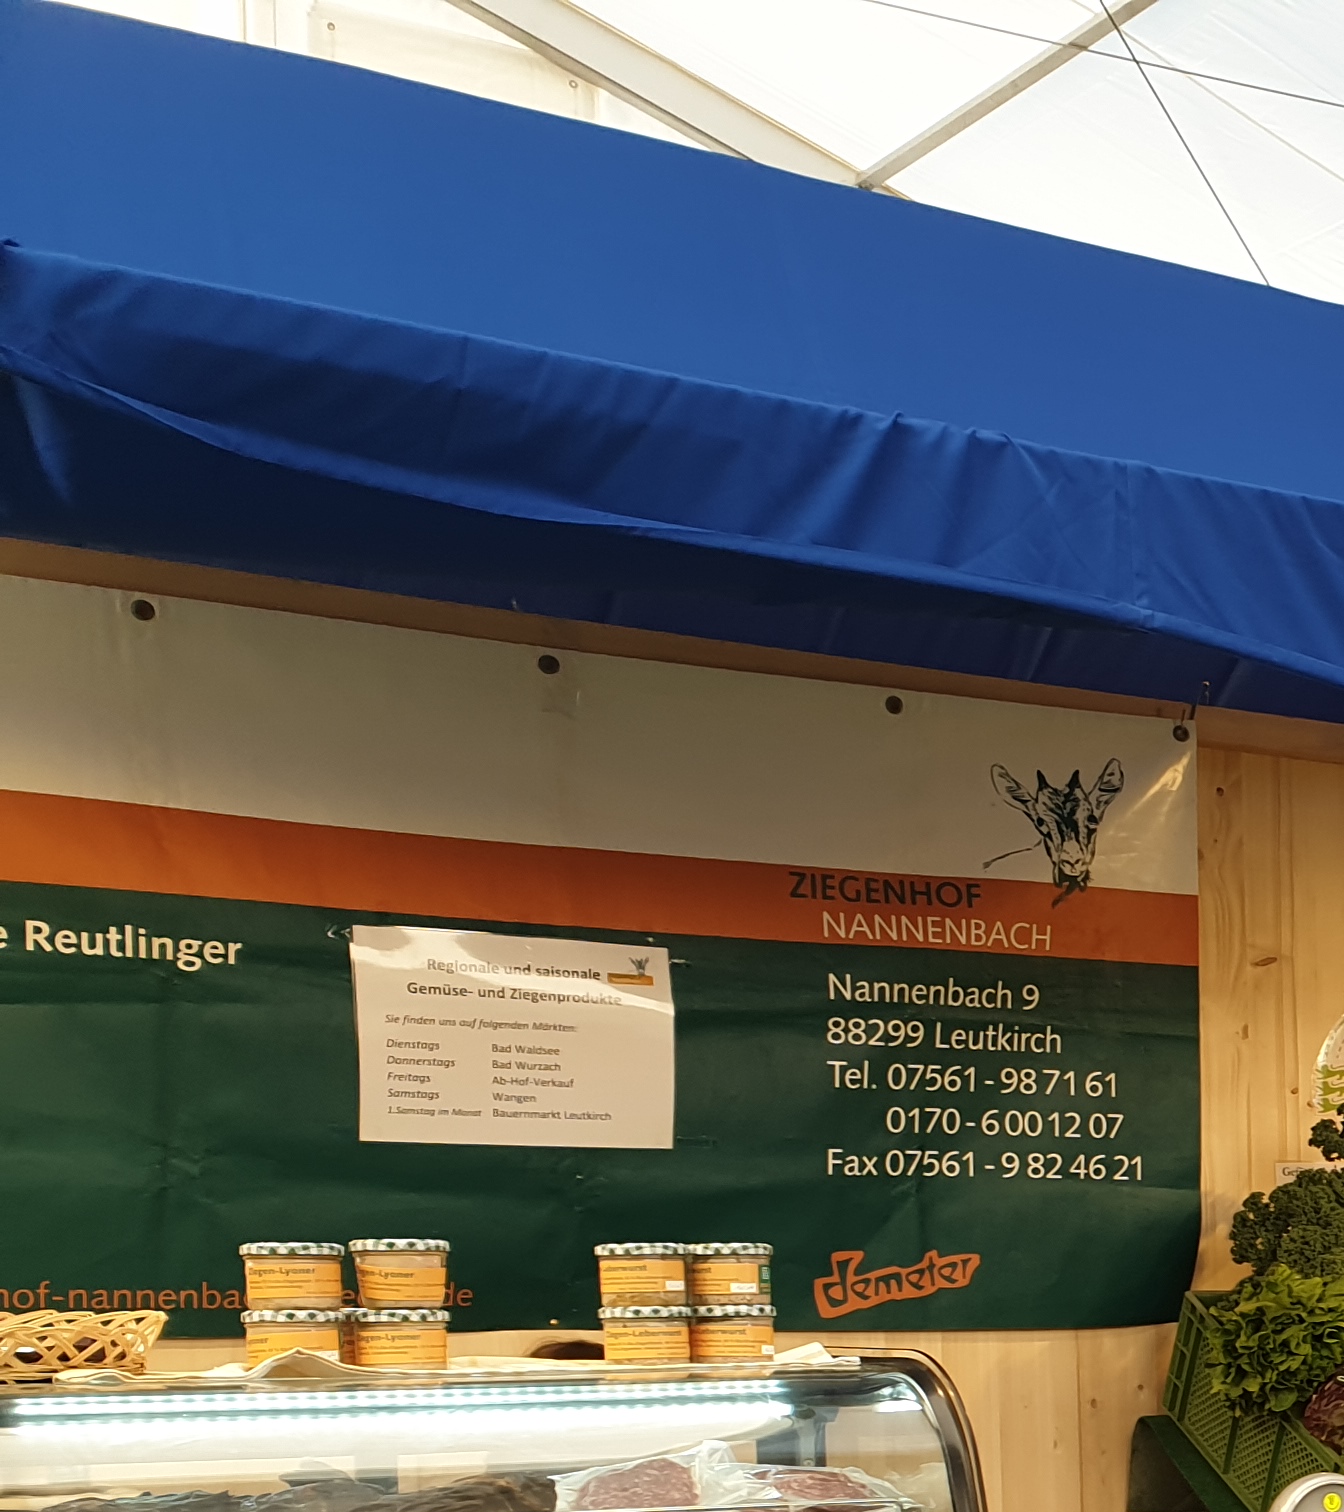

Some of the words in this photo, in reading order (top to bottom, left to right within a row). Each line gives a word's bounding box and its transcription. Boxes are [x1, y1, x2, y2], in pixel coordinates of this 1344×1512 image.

[788, 871, 981, 908] ZIEGENHOF
[24, 919, 243, 972] Reutlinger
[821, 911, 1051, 950] NANNENBACH
[427, 958, 499, 975] Regionale
[503, 963, 531, 977] und
[535, 965, 600, 980] saisonale
[407, 982, 473, 997] Gemüse-
[478, 987, 505, 1000] und
[509, 987, 622, 1006] Ziegenprodukte
[828, 973, 1013, 1009] Nannenbach
[1022, 985, 1040, 1011] 9
[826, 1017, 925, 1048] 88299
[935, 1022, 1062, 1053] Leutkirch
[827, 1060, 878, 1090] Tel.
[826, 1149, 878, 1176] Fax
[822, 1256, 972, 1308] demeter
